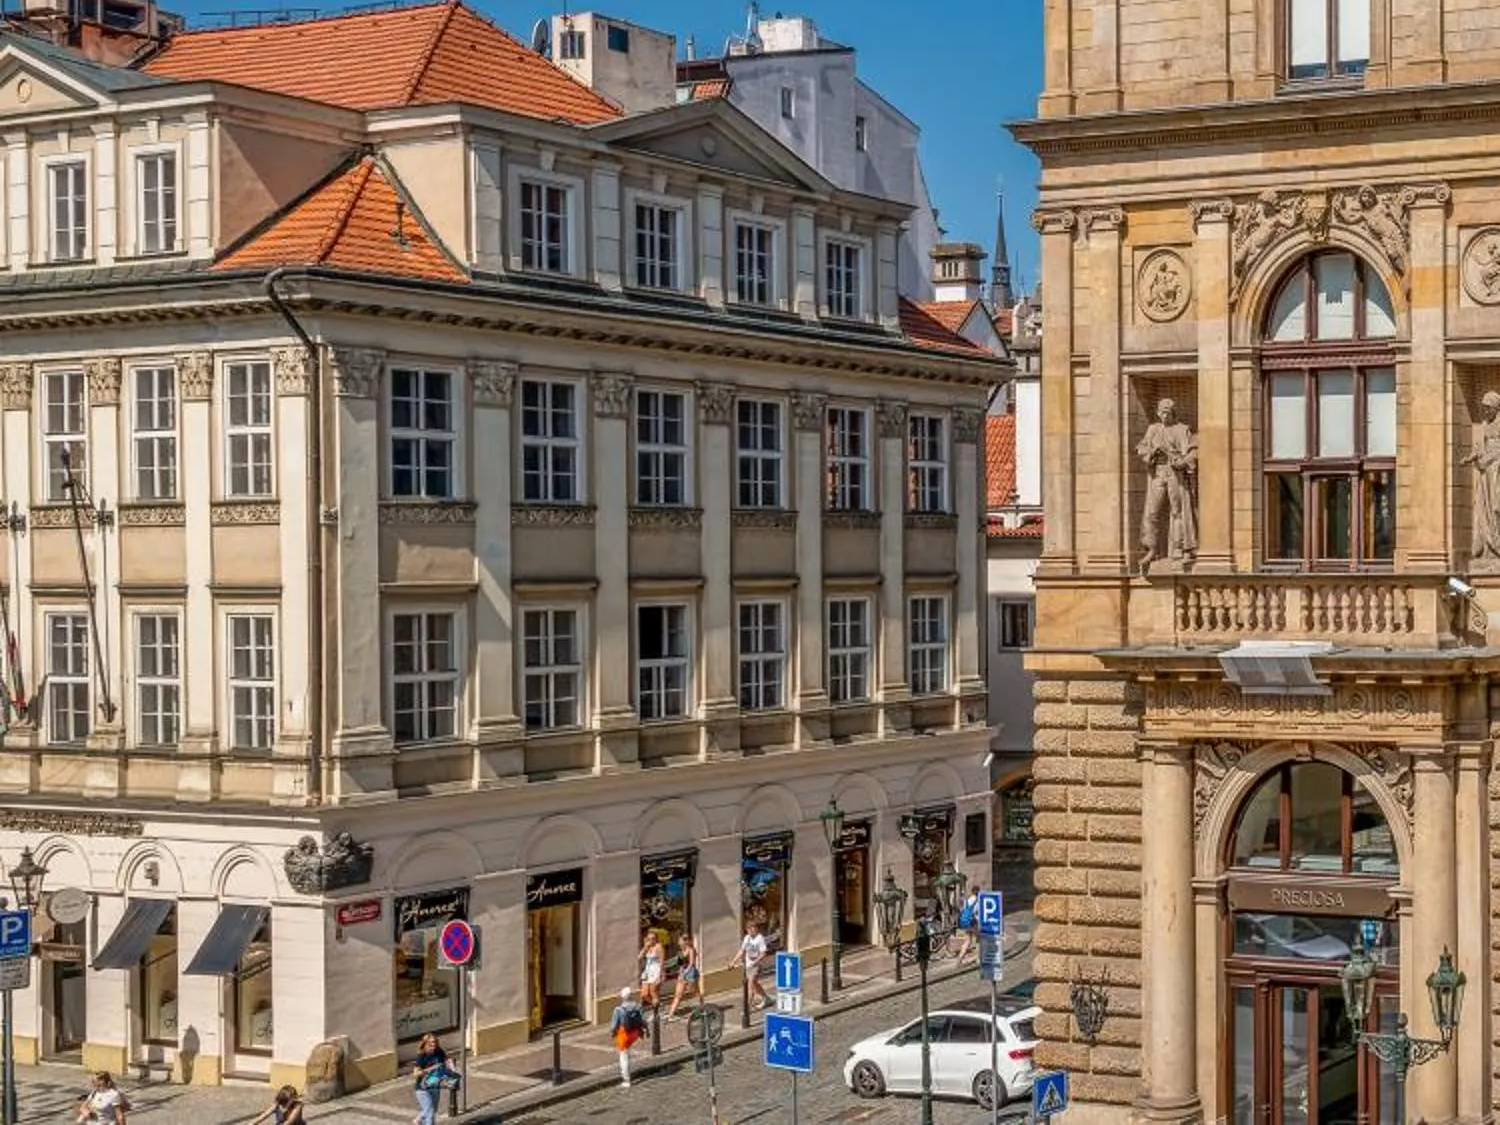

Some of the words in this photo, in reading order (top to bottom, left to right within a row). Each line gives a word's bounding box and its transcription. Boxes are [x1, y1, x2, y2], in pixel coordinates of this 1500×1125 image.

[983, 897, 997, 923] P
[1271, 888, 1345, 908] PRECIOSA
[1, 917, 24, 944] P
